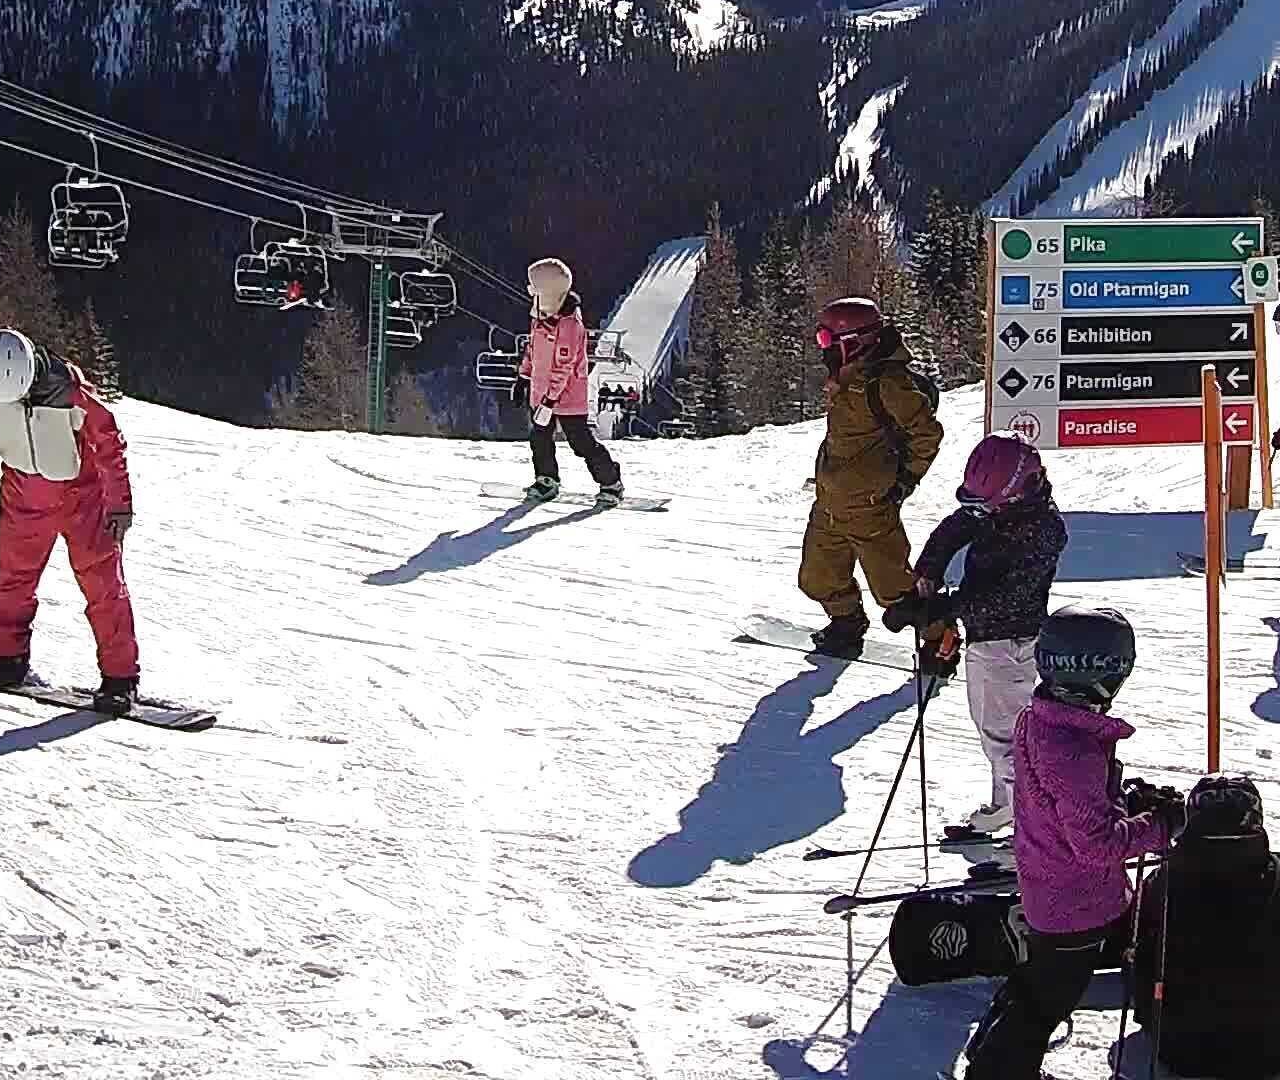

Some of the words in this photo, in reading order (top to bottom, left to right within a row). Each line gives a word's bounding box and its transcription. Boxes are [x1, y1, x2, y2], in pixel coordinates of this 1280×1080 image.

[1036, 238, 1060, 254] 65
[1070, 237, 1106, 252] Pika
[1035, 283, 1059, 298] 75
[1069, 282, 1098, 297] Old
[1103, 281, 1190, 299] Ptarmigan
[1033, 328, 1057, 344] 66
[1067, 327, 1152, 344] Exhibition
[1032, 375, 1055, 390] 76
[1066, 373, 1153, 392] Ptarmigan
[1064, 419, 1137, 436] Paradise
